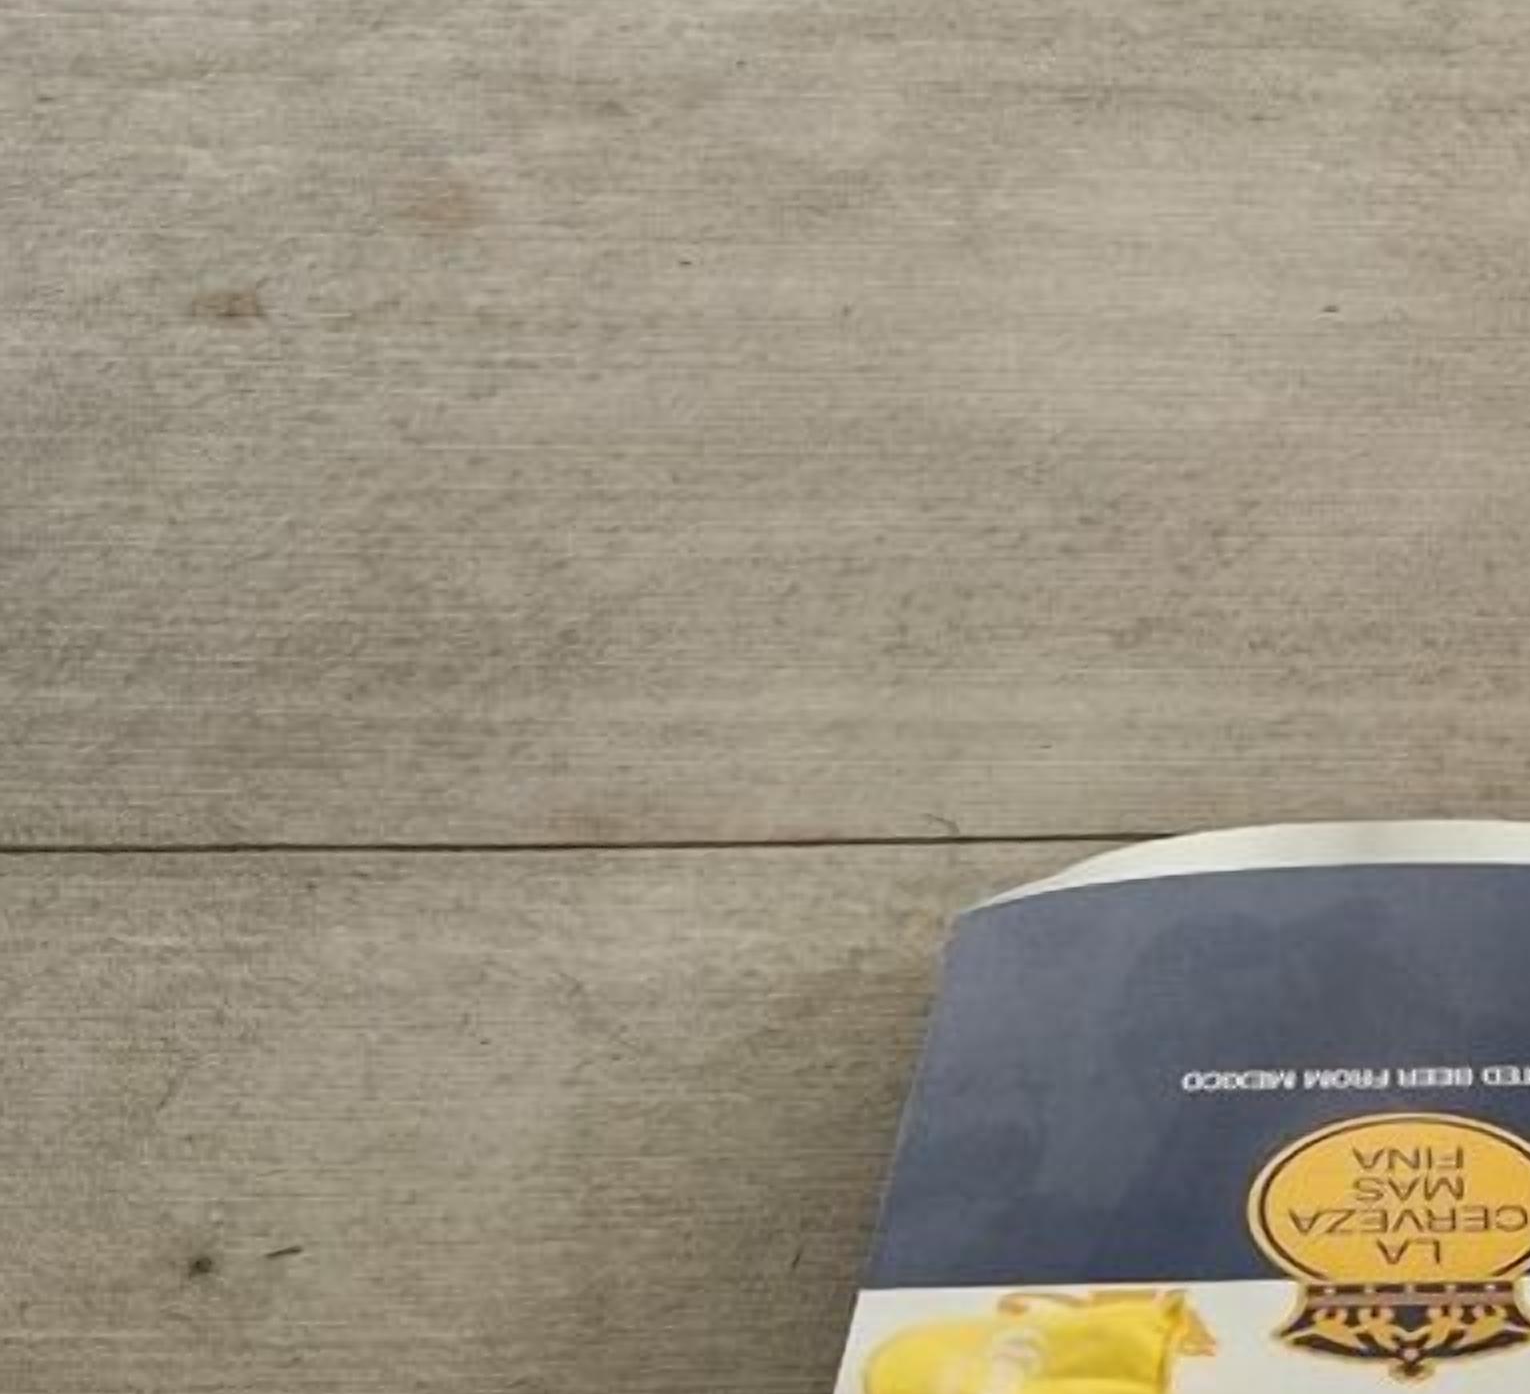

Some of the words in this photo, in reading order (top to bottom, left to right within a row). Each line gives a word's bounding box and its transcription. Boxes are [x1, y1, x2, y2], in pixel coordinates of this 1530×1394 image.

[1181, 1069, 1296, 1092] MEXICO
[1303, 1068, 1390, 1090] FROM
[1397, 1066, 1474, 1088] BEER
[1351, 1145, 1465, 1171] FINA
[1352, 1175, 1465, 1202] MAS
[1286, 1204, 1530, 1236] CERVEZA
[1375, 1238, 1443, 1265] LA
